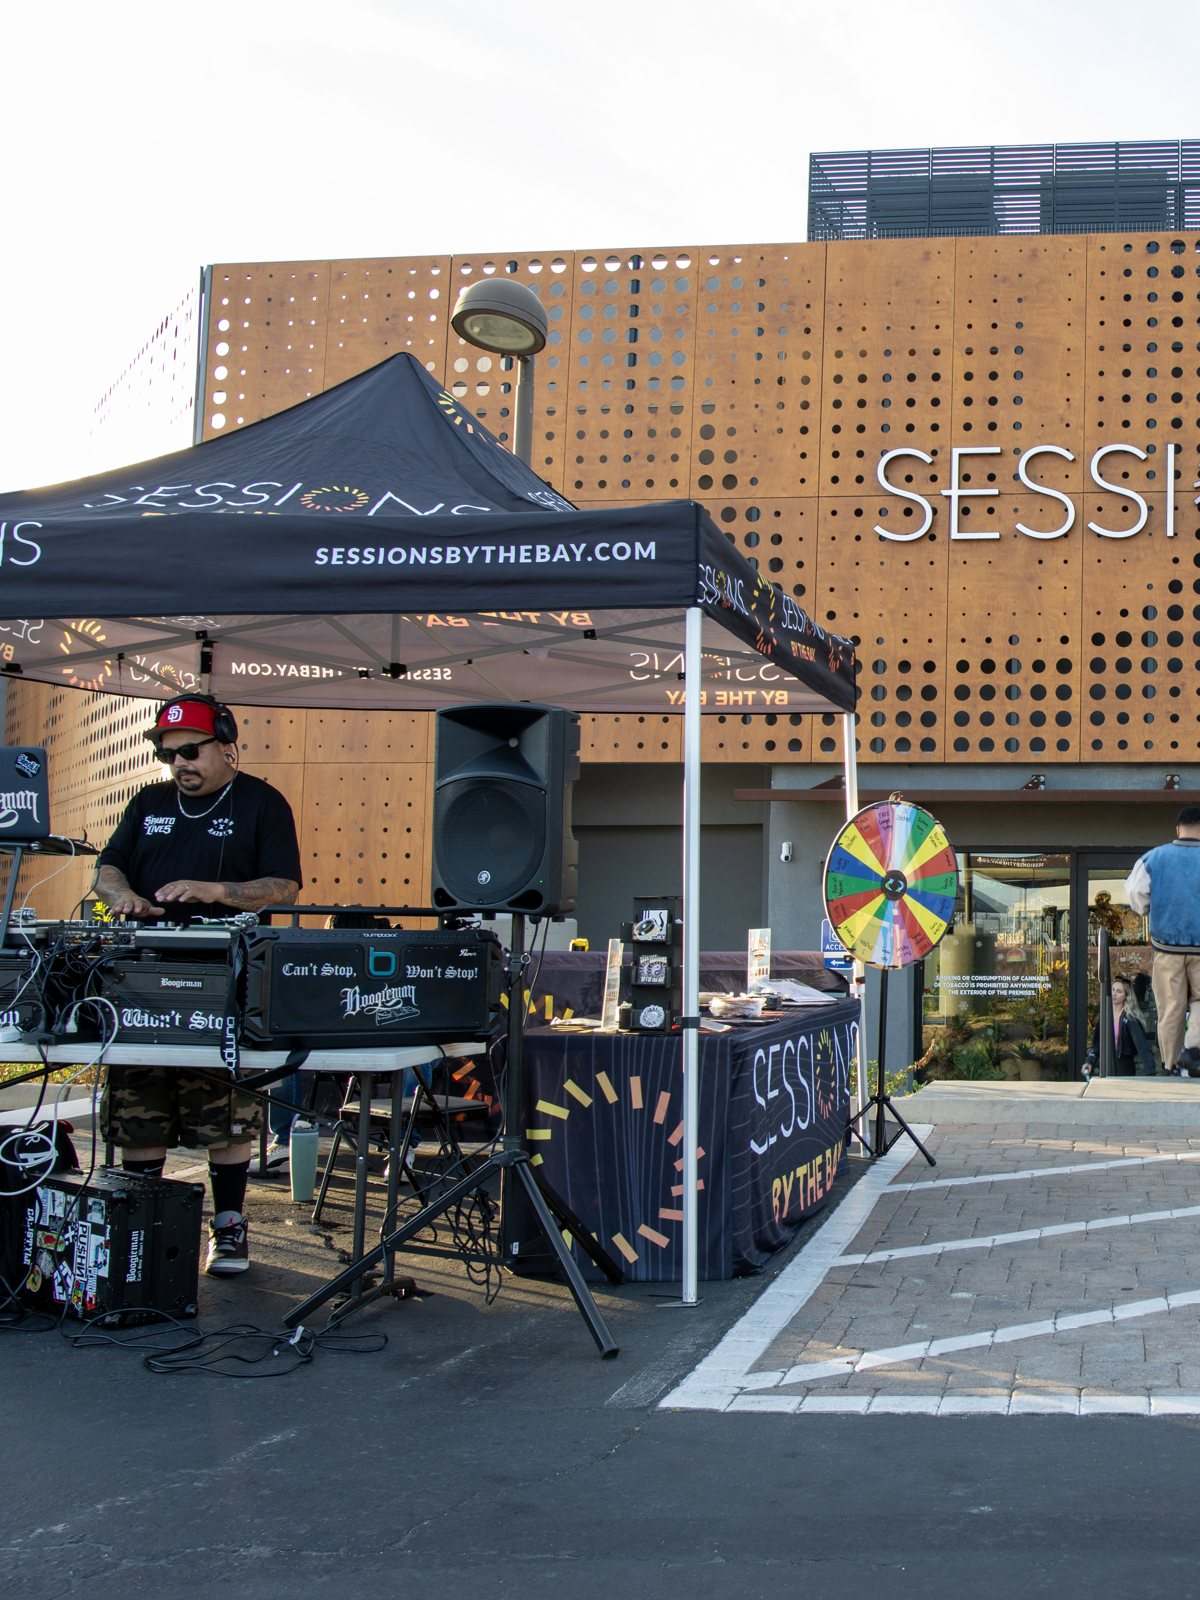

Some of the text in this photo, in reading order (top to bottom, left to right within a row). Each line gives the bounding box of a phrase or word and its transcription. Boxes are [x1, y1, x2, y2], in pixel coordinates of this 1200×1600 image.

[315, 541, 657, 566] SESSIONSBYTHEBAY.COM
[282, 962, 318, 977] Can't
[405, 964, 478, 980] Won't Stop!
[188, 1010, 224, 1030] Sto
[771, 1170, 795, 1225] BY
[796, 1154, 824, 1211] THE
